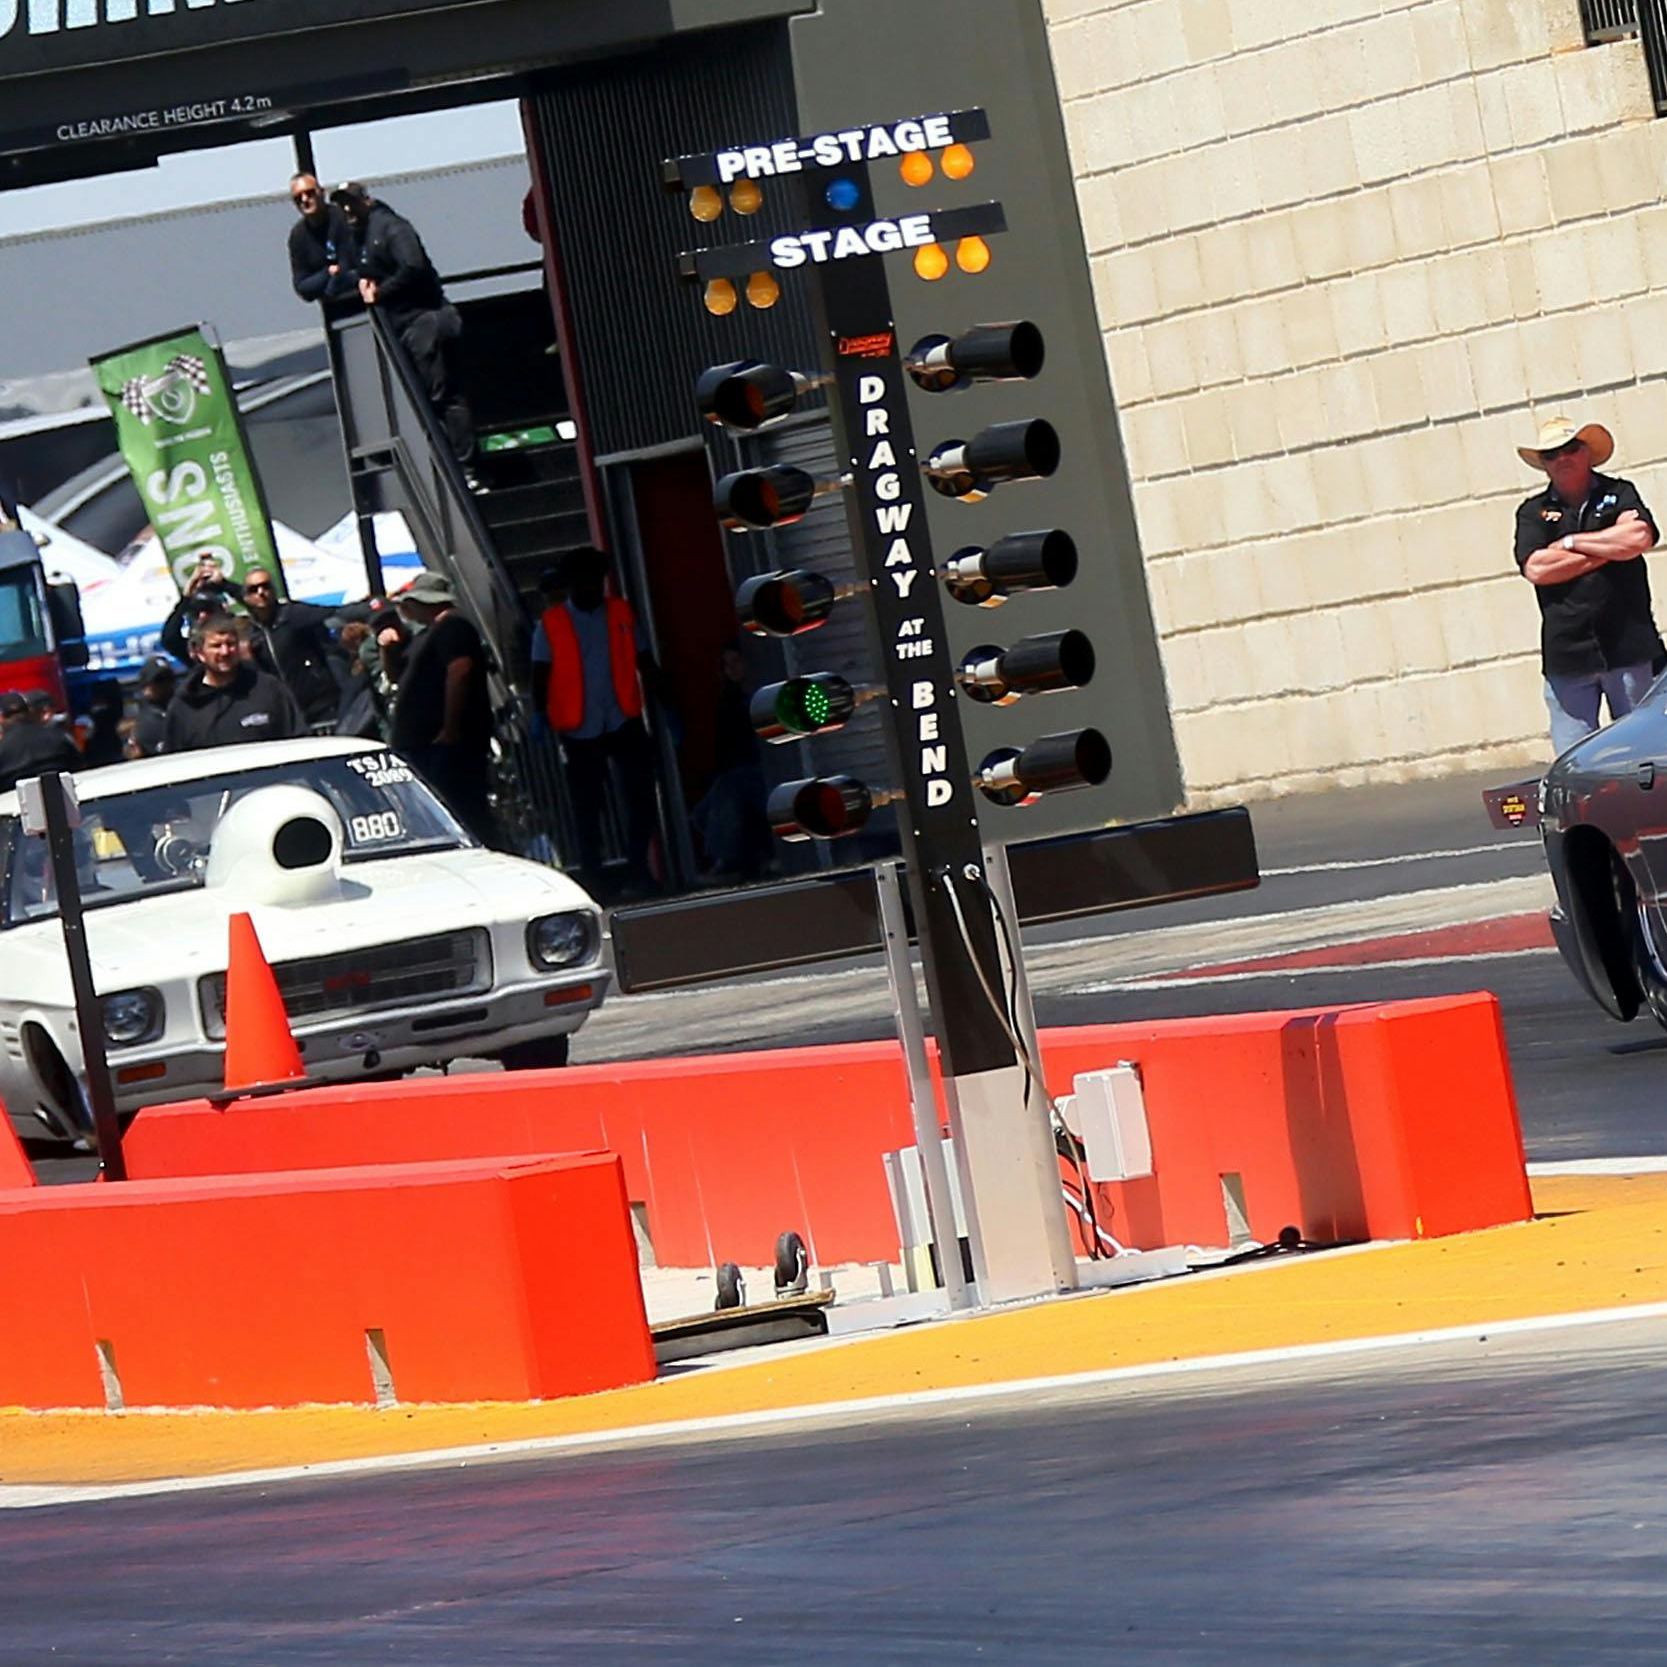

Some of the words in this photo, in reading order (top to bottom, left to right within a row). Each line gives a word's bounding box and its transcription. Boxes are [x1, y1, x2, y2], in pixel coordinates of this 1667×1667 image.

[57, 111, 160, 140] CLEARANCE
[164, 100, 226, 125] HEIGHT
[231, 95, 272, 111] 4.2m
[716, 113, 953, 183] PRE-STAGE
[770, 213, 935, 270] STAGE
[209, 451, 260, 564] ENTHUSIASTS
[858, 374, 917, 601] DRAGWAY
[895, 638, 933, 661] THE
[897, 617, 925, 639] AT
[911, 680, 952, 808] BEND
